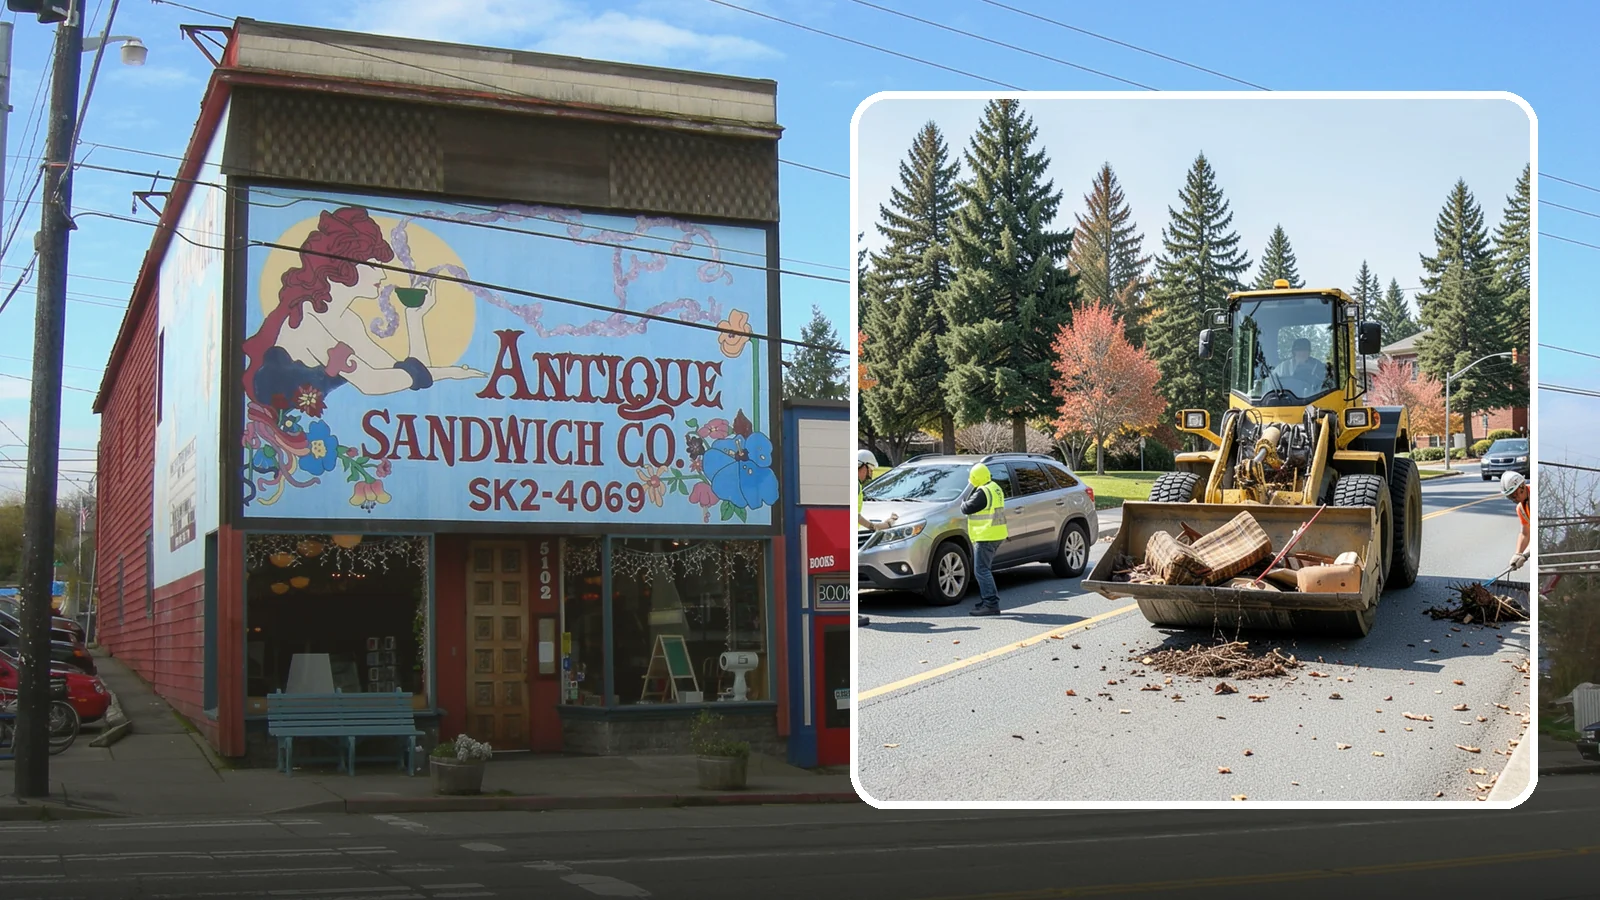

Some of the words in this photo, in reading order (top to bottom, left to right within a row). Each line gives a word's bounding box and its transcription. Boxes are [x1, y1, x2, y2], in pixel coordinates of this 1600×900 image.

[475, 328, 724, 422] ANTIQUE
[361, 408, 604, 467] SANDWICH
[616, 422, 685, 468] CO.
[468, 477, 646, 513] SK2-4069
[540, 541, 551, 600] 5102
[809, 555, 835, 569] BOOKS
